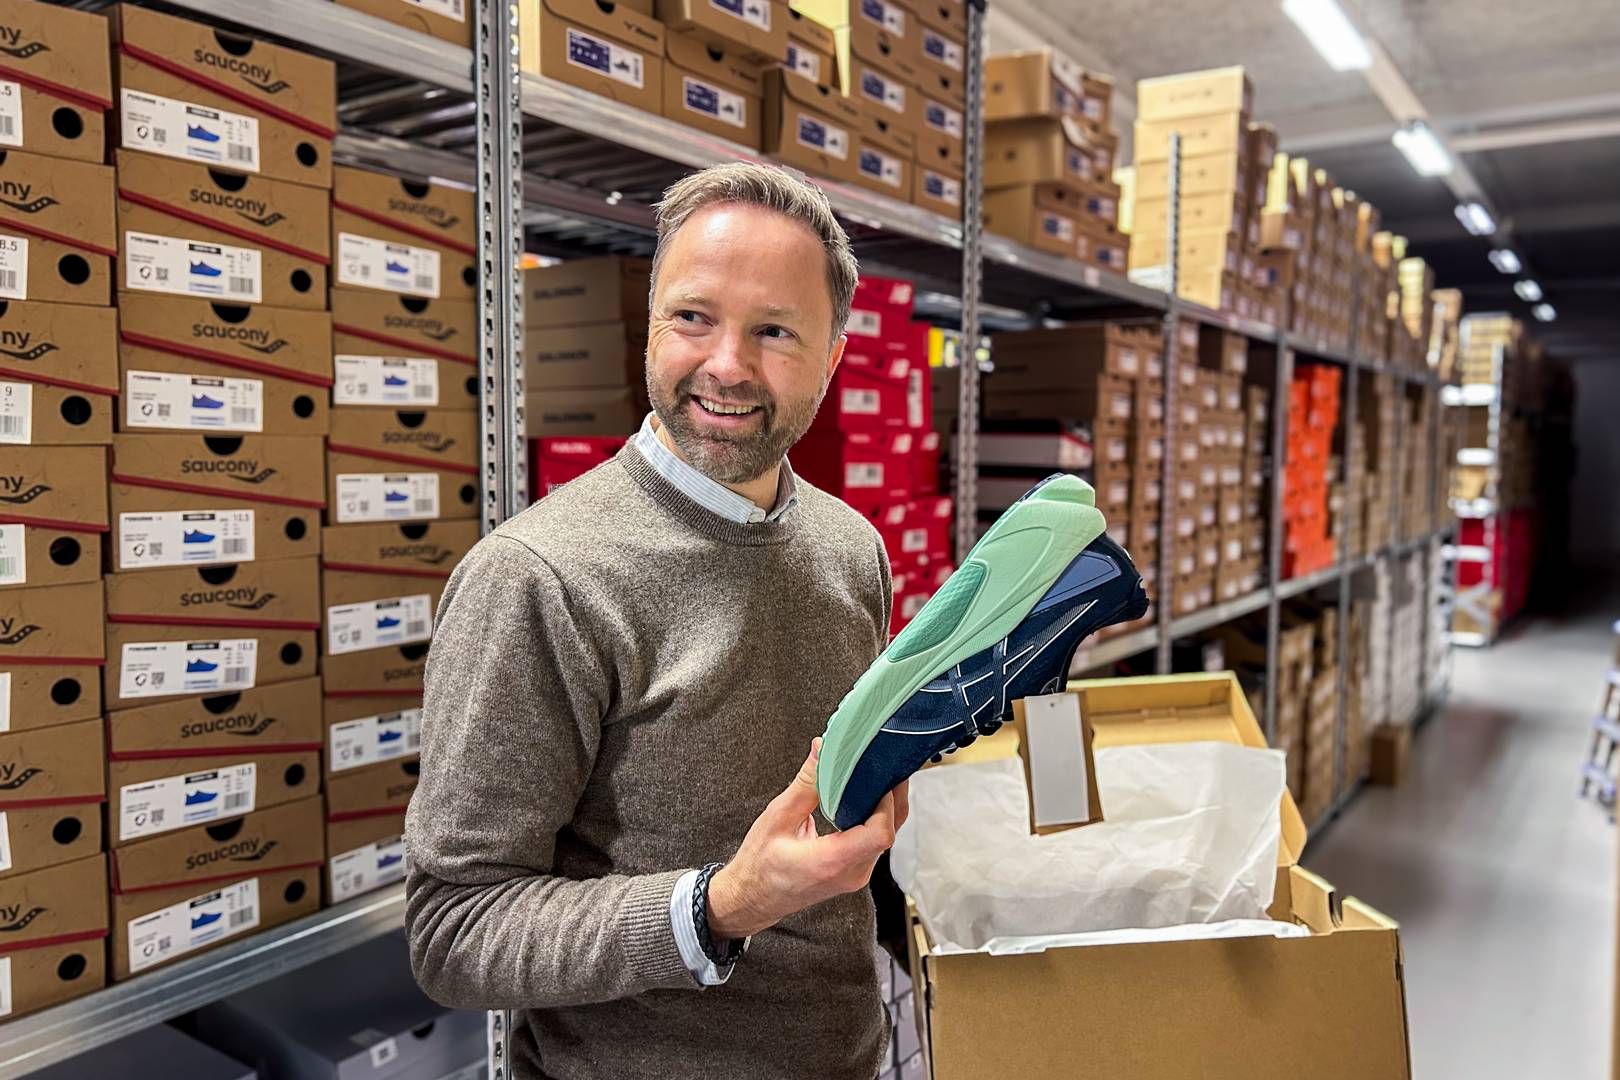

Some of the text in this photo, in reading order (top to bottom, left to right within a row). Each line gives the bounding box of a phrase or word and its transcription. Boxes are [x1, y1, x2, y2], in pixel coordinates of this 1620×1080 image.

[194, 47, 271, 79] saucony
[0, 85, 13, 97] .5
[190, 187, 267, 215] saucony
[387, 198, 447, 220] saucony
[192, 323, 269, 343] saucony
[181, 459, 258, 475] saucony
[180, 587, 257, 607] saucony
[180, 711, 258, 738] saucony
[186, 838, 260, 870] saucony
